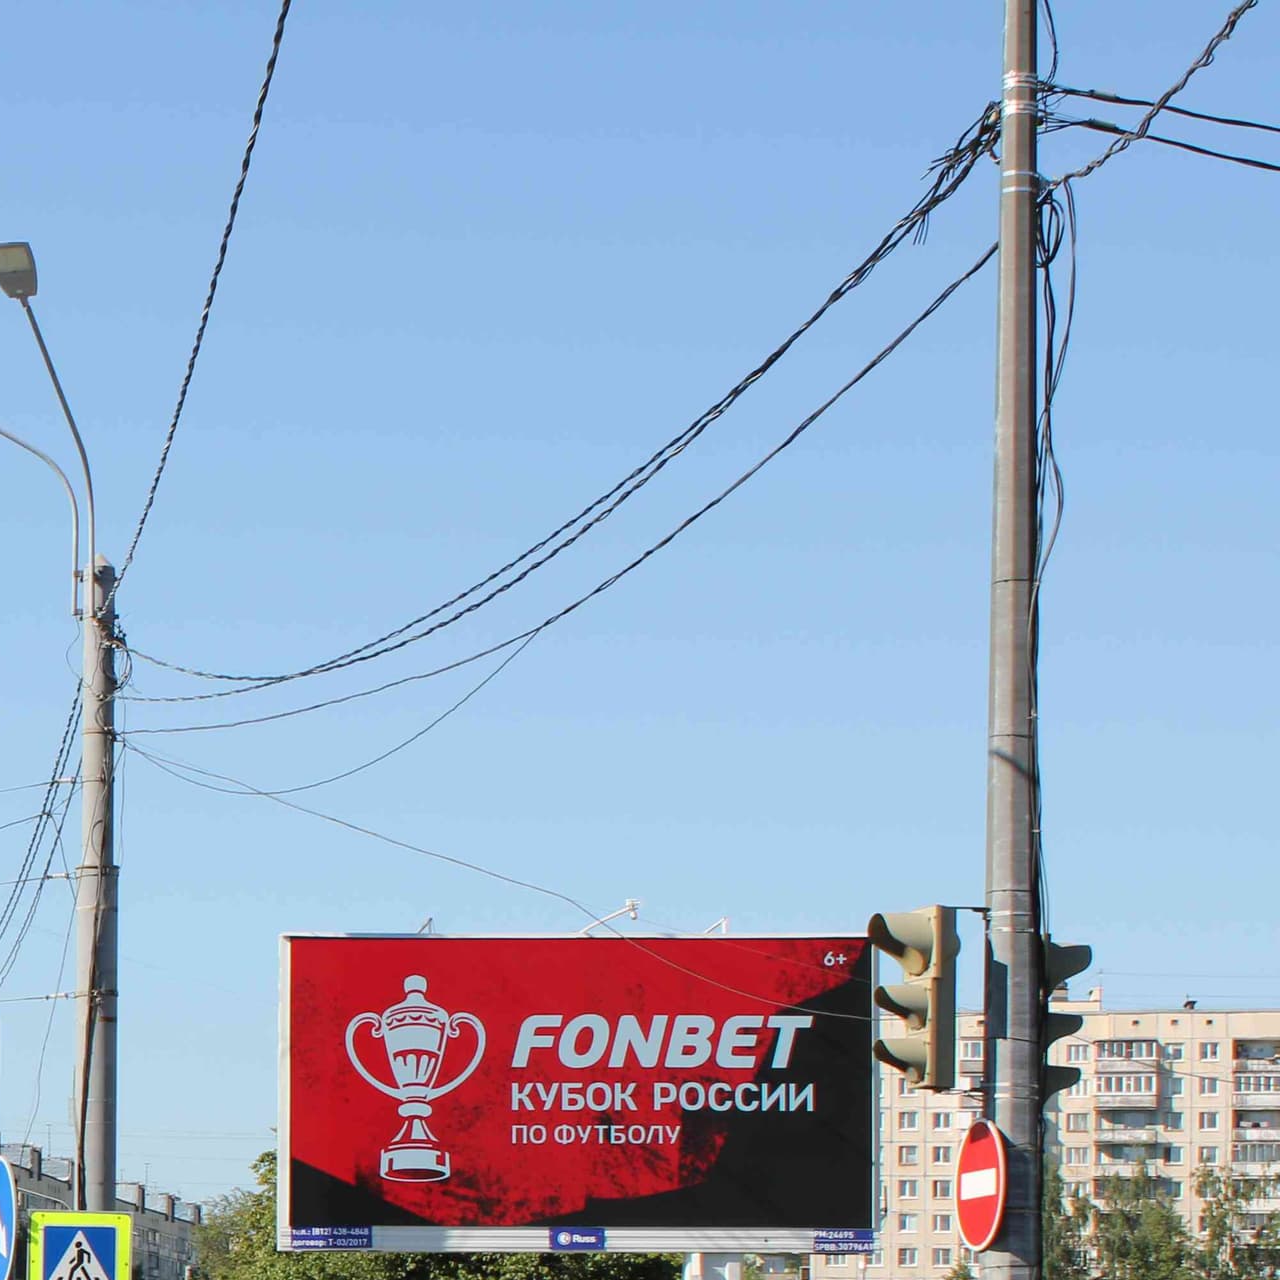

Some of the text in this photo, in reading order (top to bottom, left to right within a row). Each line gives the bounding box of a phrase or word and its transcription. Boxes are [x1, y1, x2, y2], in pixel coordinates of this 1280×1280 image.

[823, 951, 847, 966] 6+
[511, 1013, 814, 1069] FONBET
[511, 1082, 814, 1112] КУБОК РОССИИ
[511, 1124, 681, 1145] ПО ФУТБОЛУ
[572, 1234, 596, 1243] Russ
